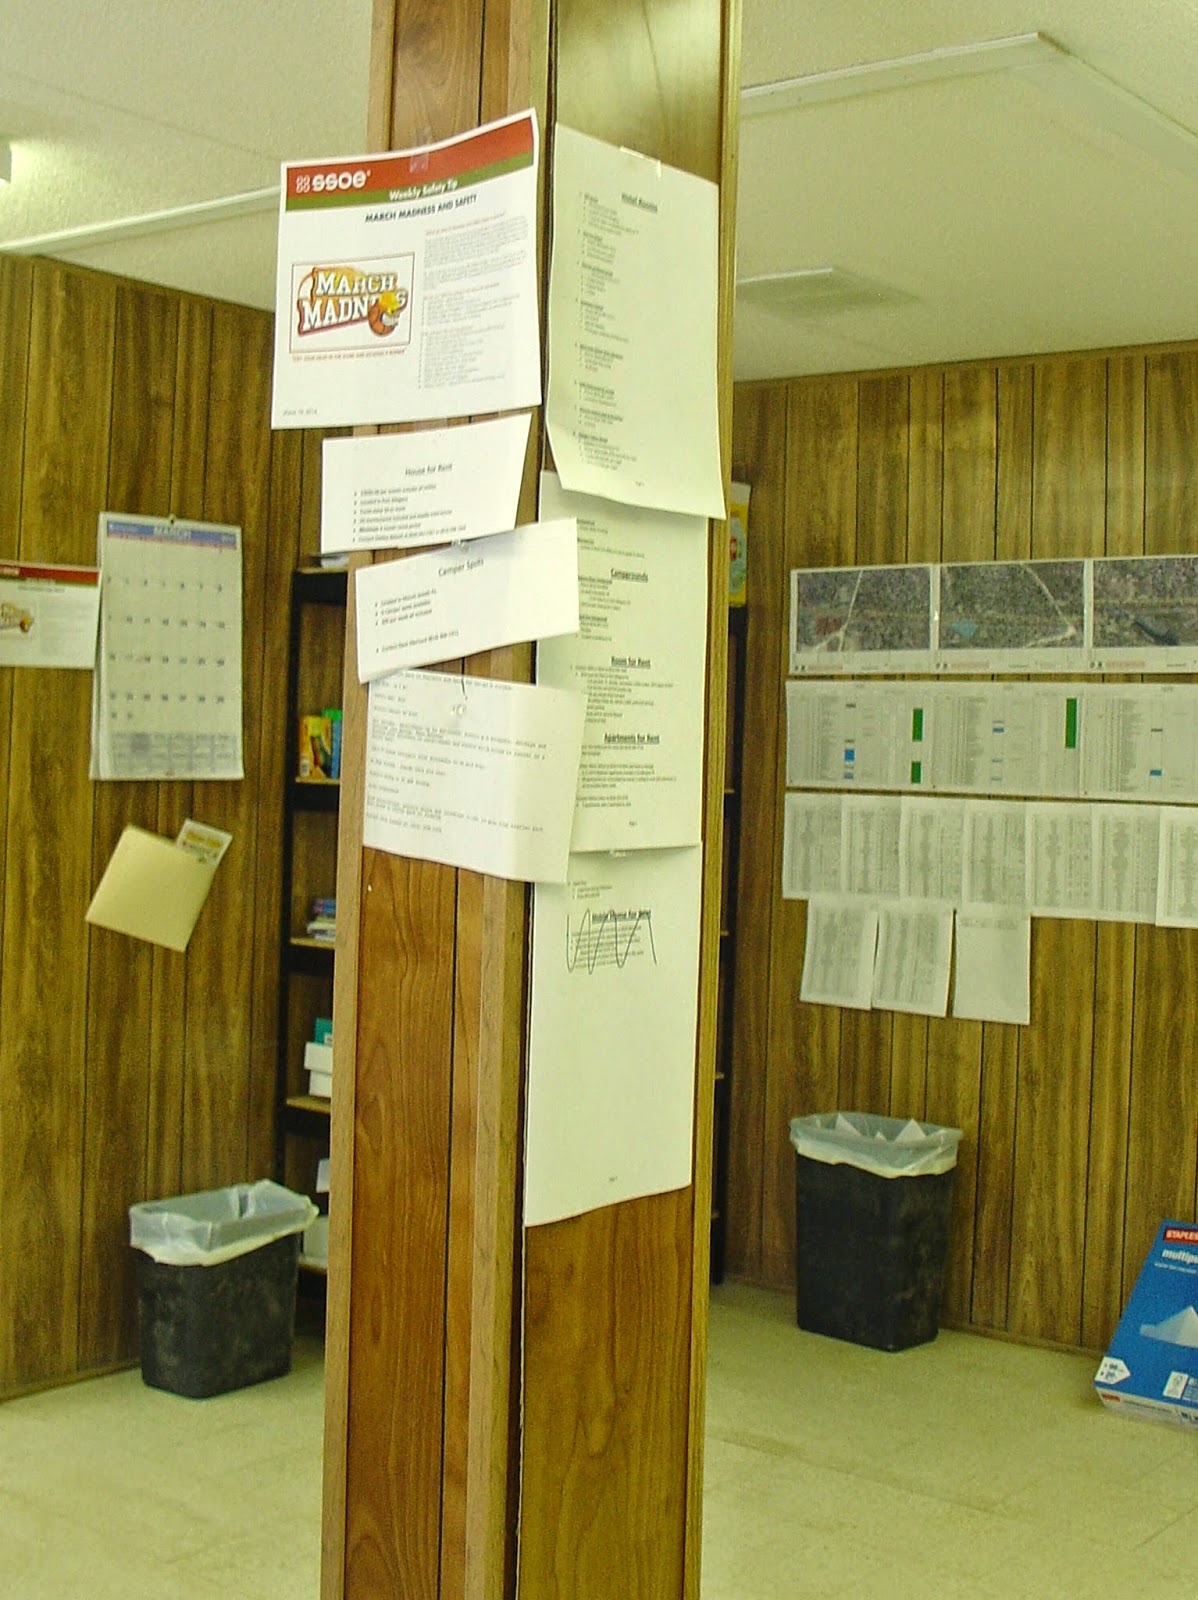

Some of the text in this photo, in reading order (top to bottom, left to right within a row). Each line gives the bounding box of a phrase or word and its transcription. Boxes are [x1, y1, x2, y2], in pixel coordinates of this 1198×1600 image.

[389, 186, 421, 201] Weekly
[365, 193, 479, 223] MARCH MADNESS AND SAFETY
[315, 271, 396, 295] MARCH
